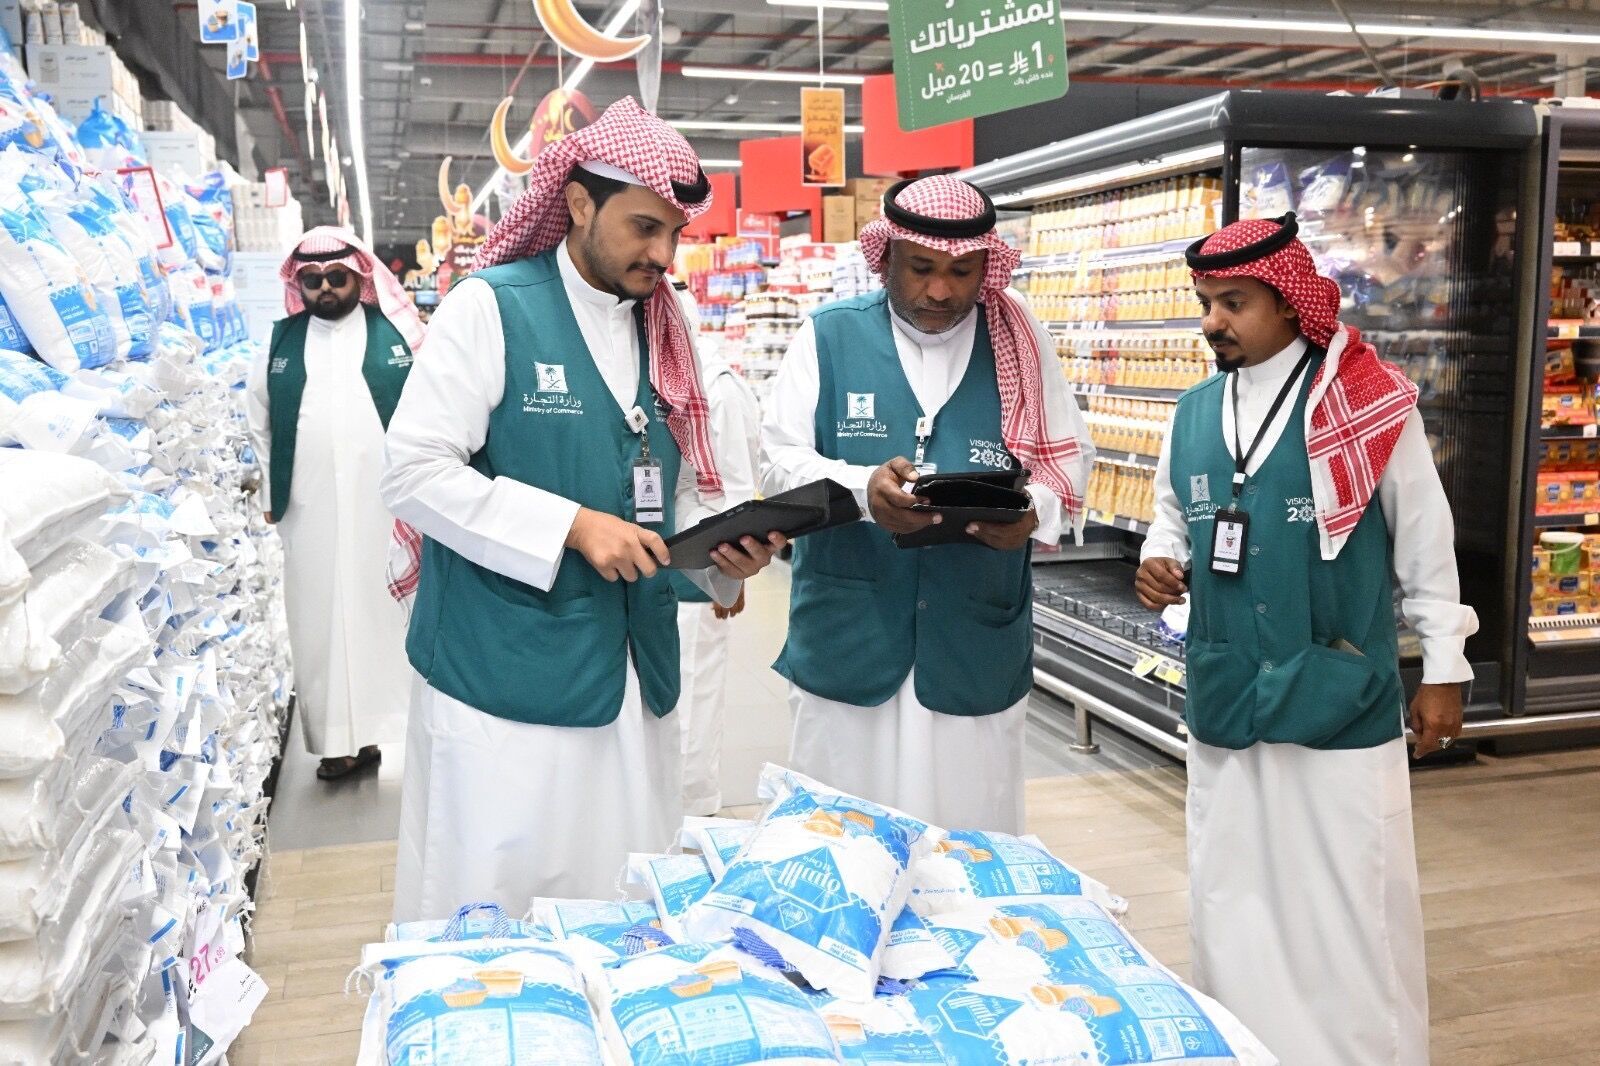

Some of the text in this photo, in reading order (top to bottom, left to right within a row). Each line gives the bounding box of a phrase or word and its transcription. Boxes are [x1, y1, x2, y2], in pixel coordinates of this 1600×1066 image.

[909, 0, 1055, 54] بمشترياتك
[1031, 41, 1043, 69] 1
[959, 60, 985, 86] 20
[921, 73, 957, 100] ميل
[523, 392, 582, 408] وزارة التجارة
[523, 406, 545, 415] Ministry
[866, 420, 887, 432] وزارة
[969, 438, 996, 449] VISION
